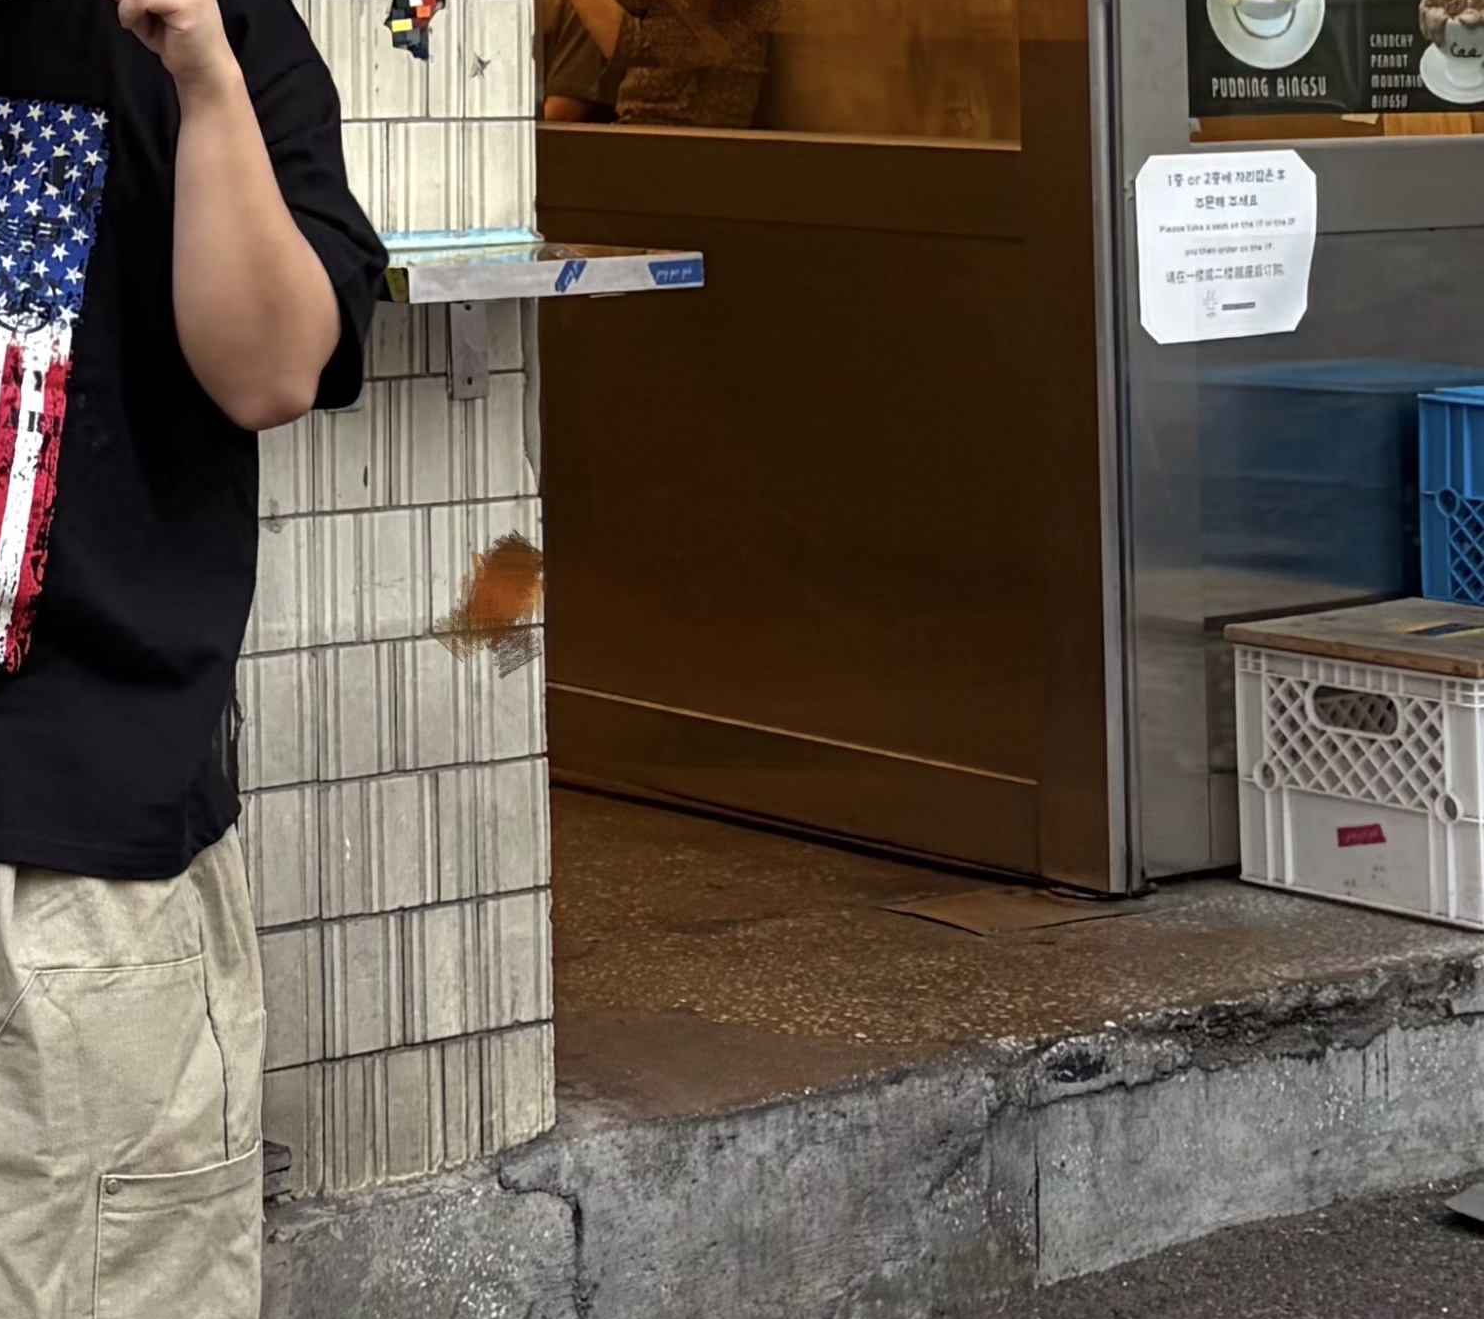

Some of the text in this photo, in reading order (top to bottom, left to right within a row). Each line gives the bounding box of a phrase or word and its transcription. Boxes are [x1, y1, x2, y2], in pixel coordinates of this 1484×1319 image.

[1371, 54, 1408, 68] PEANUT
[1211, 75, 1327, 98] PUDDING BINGSU
[1371, 94, 1408, 109] BINGSU
[1187, 175, 1201, 186] or
